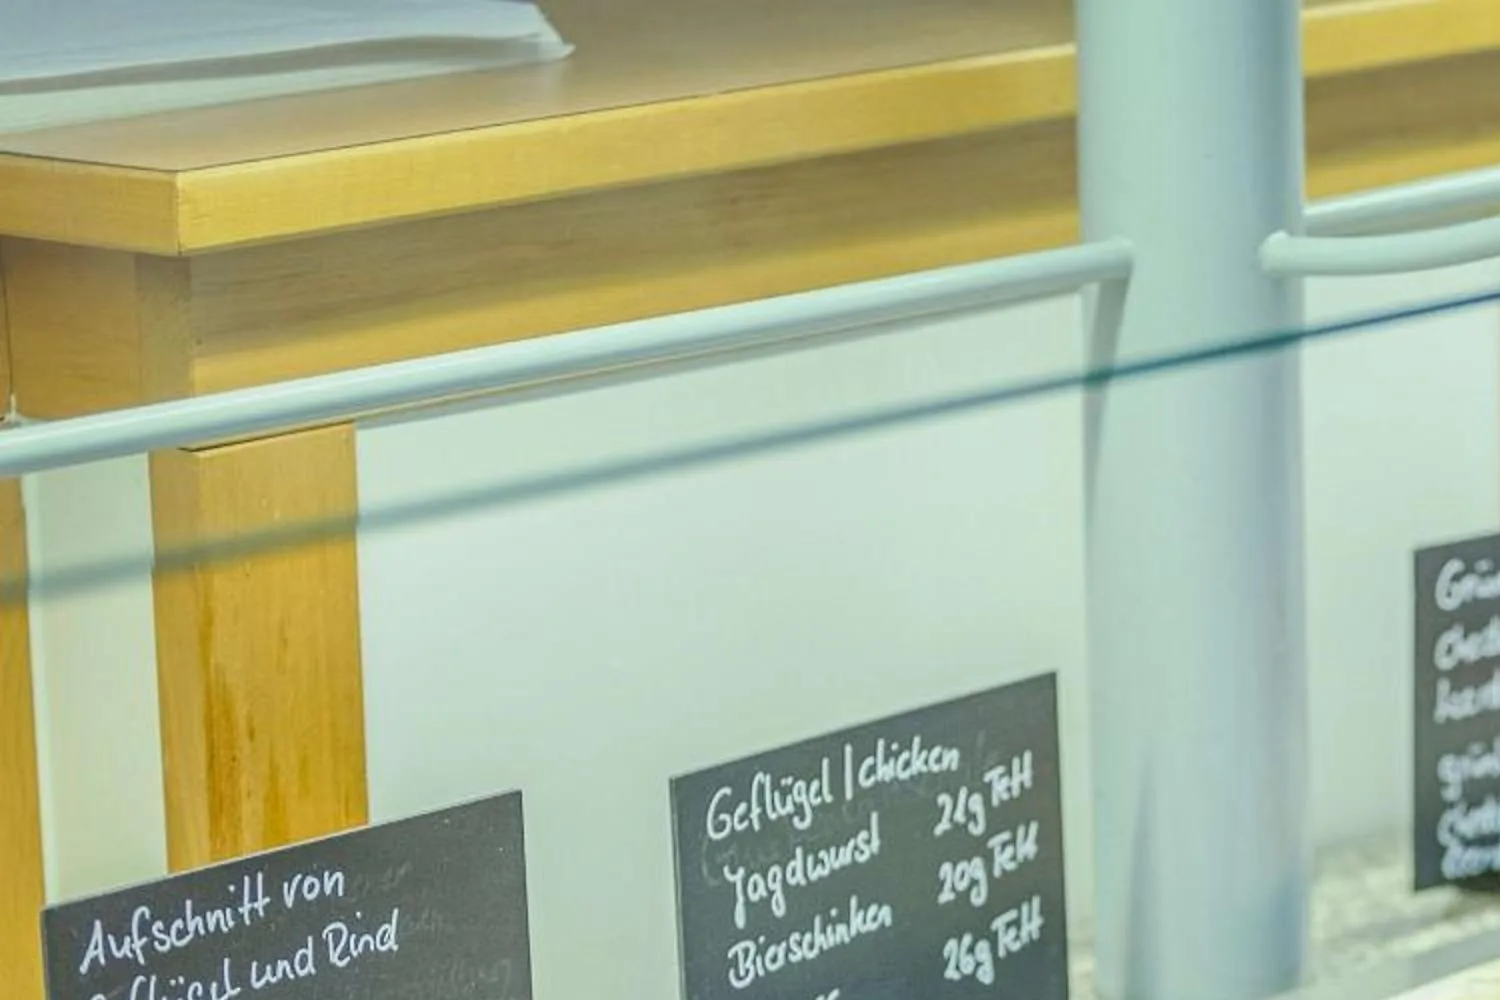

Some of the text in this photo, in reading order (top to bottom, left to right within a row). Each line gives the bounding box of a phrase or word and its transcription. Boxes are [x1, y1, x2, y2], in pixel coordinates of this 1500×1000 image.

[706, 757, 833, 840] Geflügel
[858, 735, 960, 789] chicken
[79, 870, 344, 974] Aufschnitt von
[937, 856, 988, 908] 20g
[251, 936, 316, 989] und
[322, 908, 399, 967] Rind
